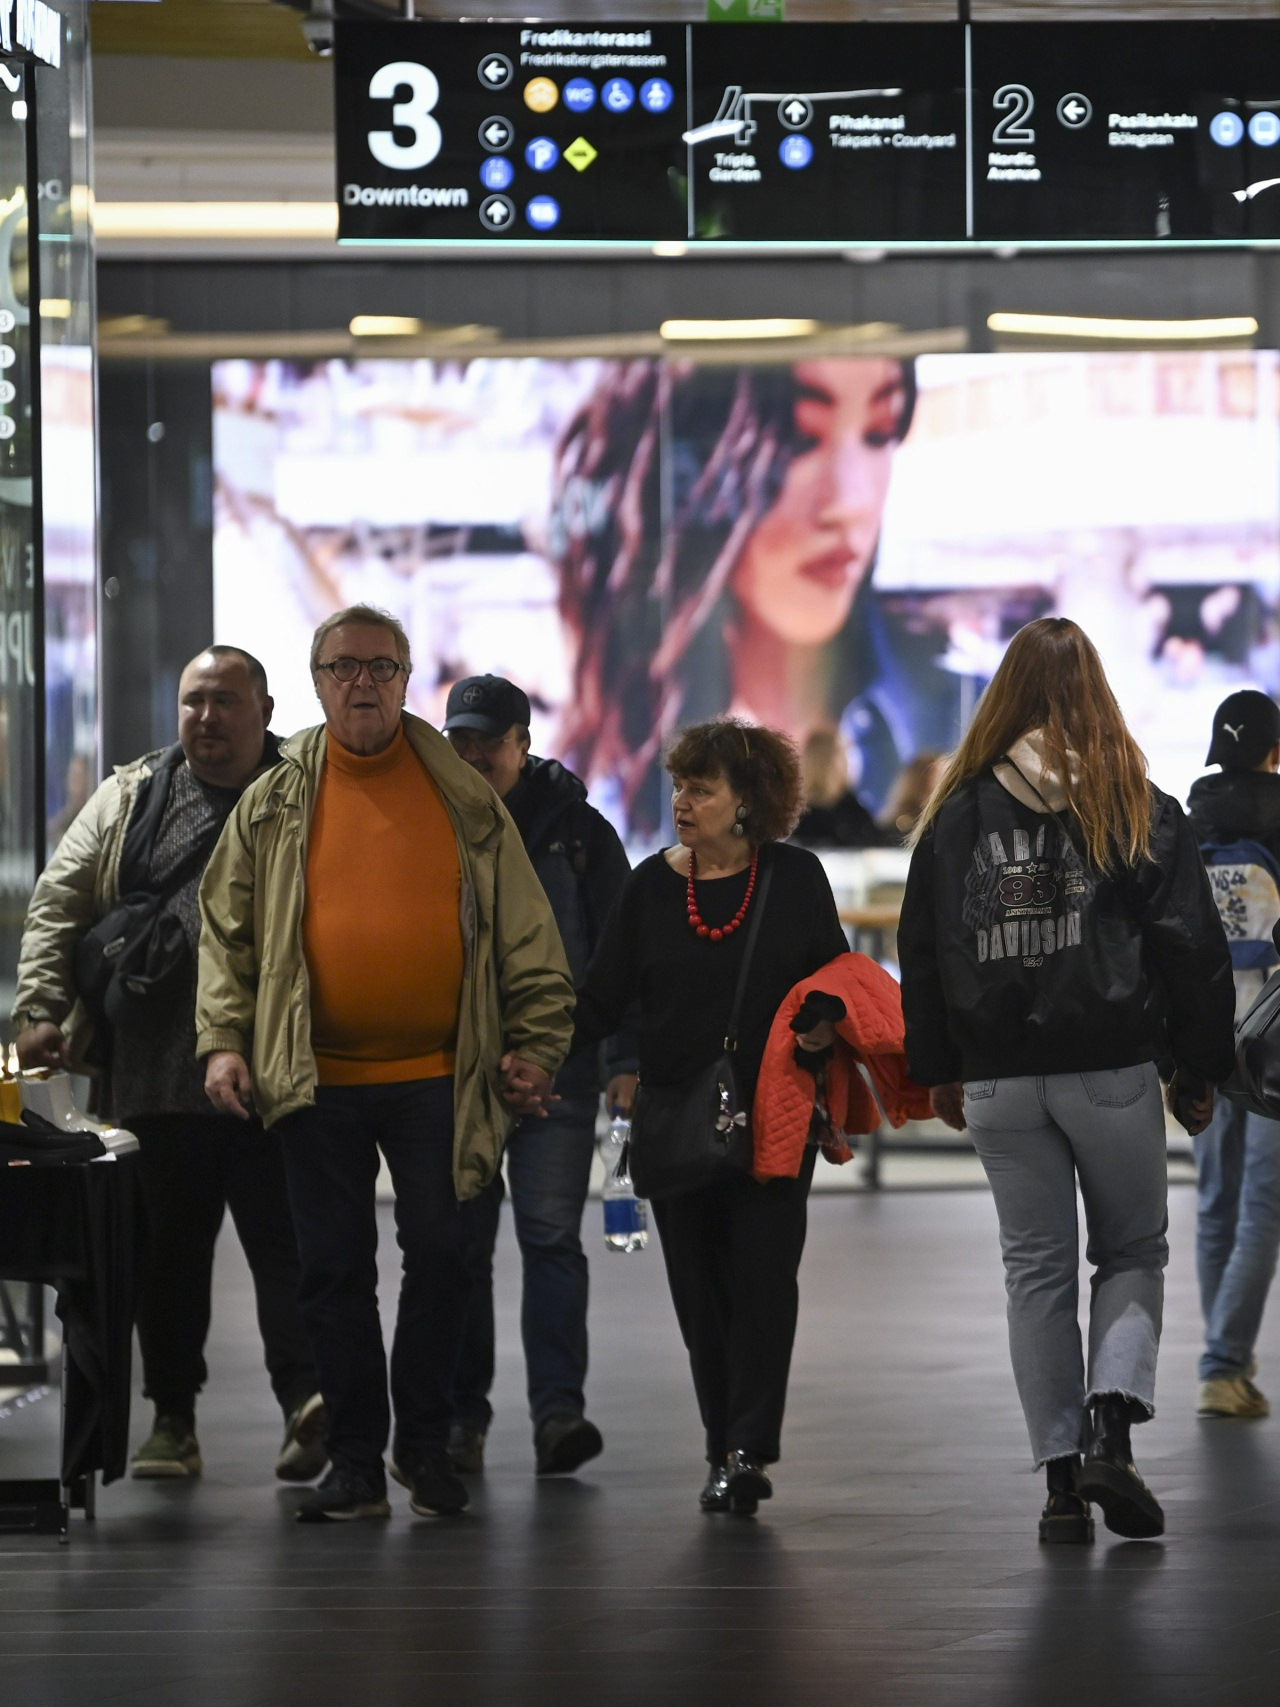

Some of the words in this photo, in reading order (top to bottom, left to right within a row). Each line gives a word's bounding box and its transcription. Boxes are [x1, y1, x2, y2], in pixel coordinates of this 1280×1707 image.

[367, 61, 442, 170] 3
[566, 87, 594, 103] WC
[992, 83, 1036, 144] 2
[343, 183, 469, 208] Downtown
[976, 910, 1082, 963] DAVIDSON
